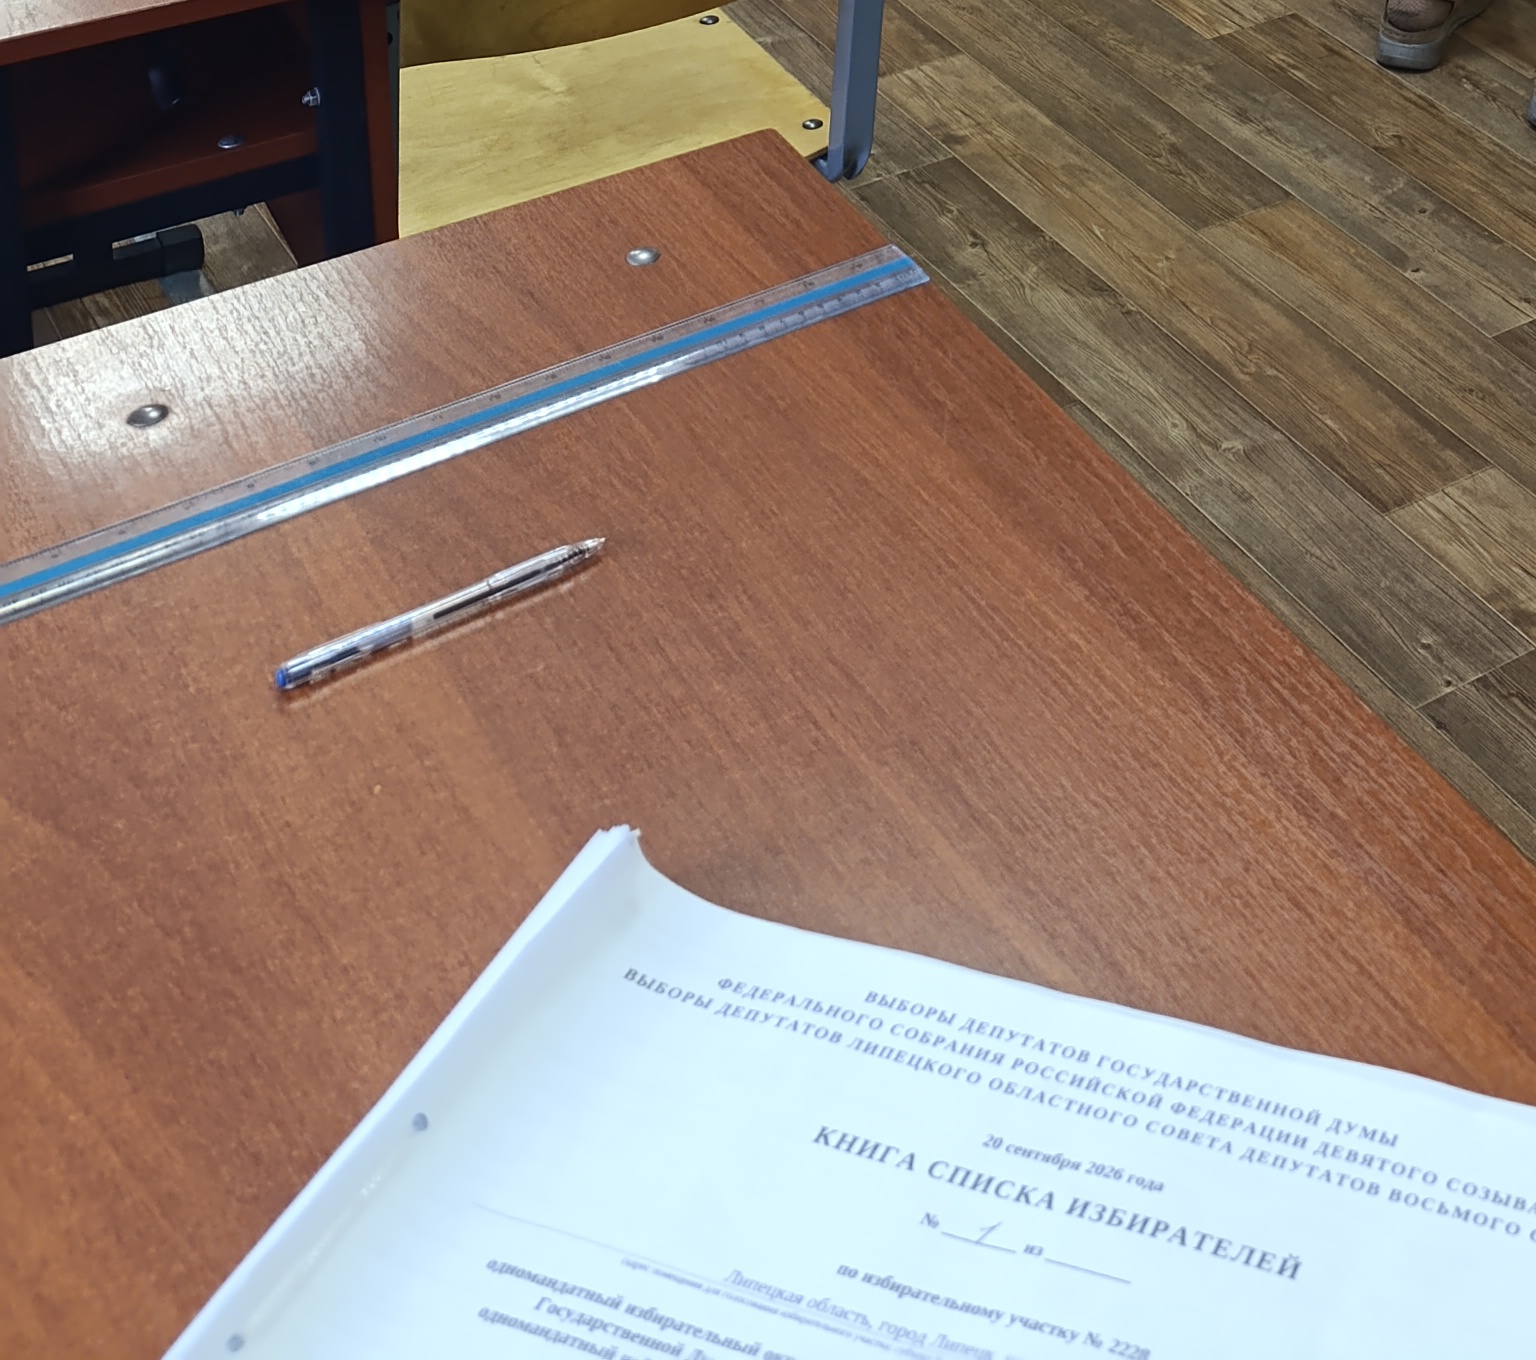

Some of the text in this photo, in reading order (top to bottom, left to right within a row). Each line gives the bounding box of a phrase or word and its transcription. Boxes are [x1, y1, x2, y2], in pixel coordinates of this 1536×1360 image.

[623, 968, 713, 1010] ВЫБОРЫ
[714, 1002, 843, 1045] ДЕПУТАТОВ
[847, 1037, 982, 1085] ЛИПЕЦКОГО
[988, 1077, 1138, 1128] ОБЛАСТНОГО
[1146, 1119, 1234, 1155] СОВЕТА
[1239, 1146, 1381, 1196] ДЕПУТАТОВ
[1388, 1188, 1521, 1236] ВОСЬМОГО
[717, 977, 883, 1031] ФЕДЕРАЛЬНОГО
[890, 1022, 1006, 1066] СОБРАНИЯ
[1010, 1056, 1163, 1110] РОССИЙСКОЙ
[1170, 1101, 1310, 1149] ФЕДЕРАЦИИ
[1313, 1141, 1438, 1186] ДЕВЯТОГО
[864, 990, 1400, 1147] ВЫБОРЫ ДЕПУТАТОВ ГОСУДАРСТВЕННОЙ ДУМЫ
[812, 1125, 1302, 1281] КНИГА СПИСКА ИЗБИРАТЕЛЕЙ
[982, 1133, 1165, 1193] 20 сентября 2026 года
[920, 1211, 940, 1230] №
[1023, 1243, 1044, 1257] из
[478, 1307, 618, 1360] одномандатный
[486, 1258, 624, 1310] одномандатный
[624, 1302, 763, 1357] избирательный
[533, 1296, 685, 1359] Государственной
[724, 1268, 805, 1305] Липецкая
[807, 1296, 873, 1330] область,
[877, 1320, 928, 1347] город
[836, 1264, 858, 1279] по
[861, 1270, 1005, 1323] избирательному
[1005, 1312, 1081, 1344] участку
[1083, 1332, 1104, 1350] №
